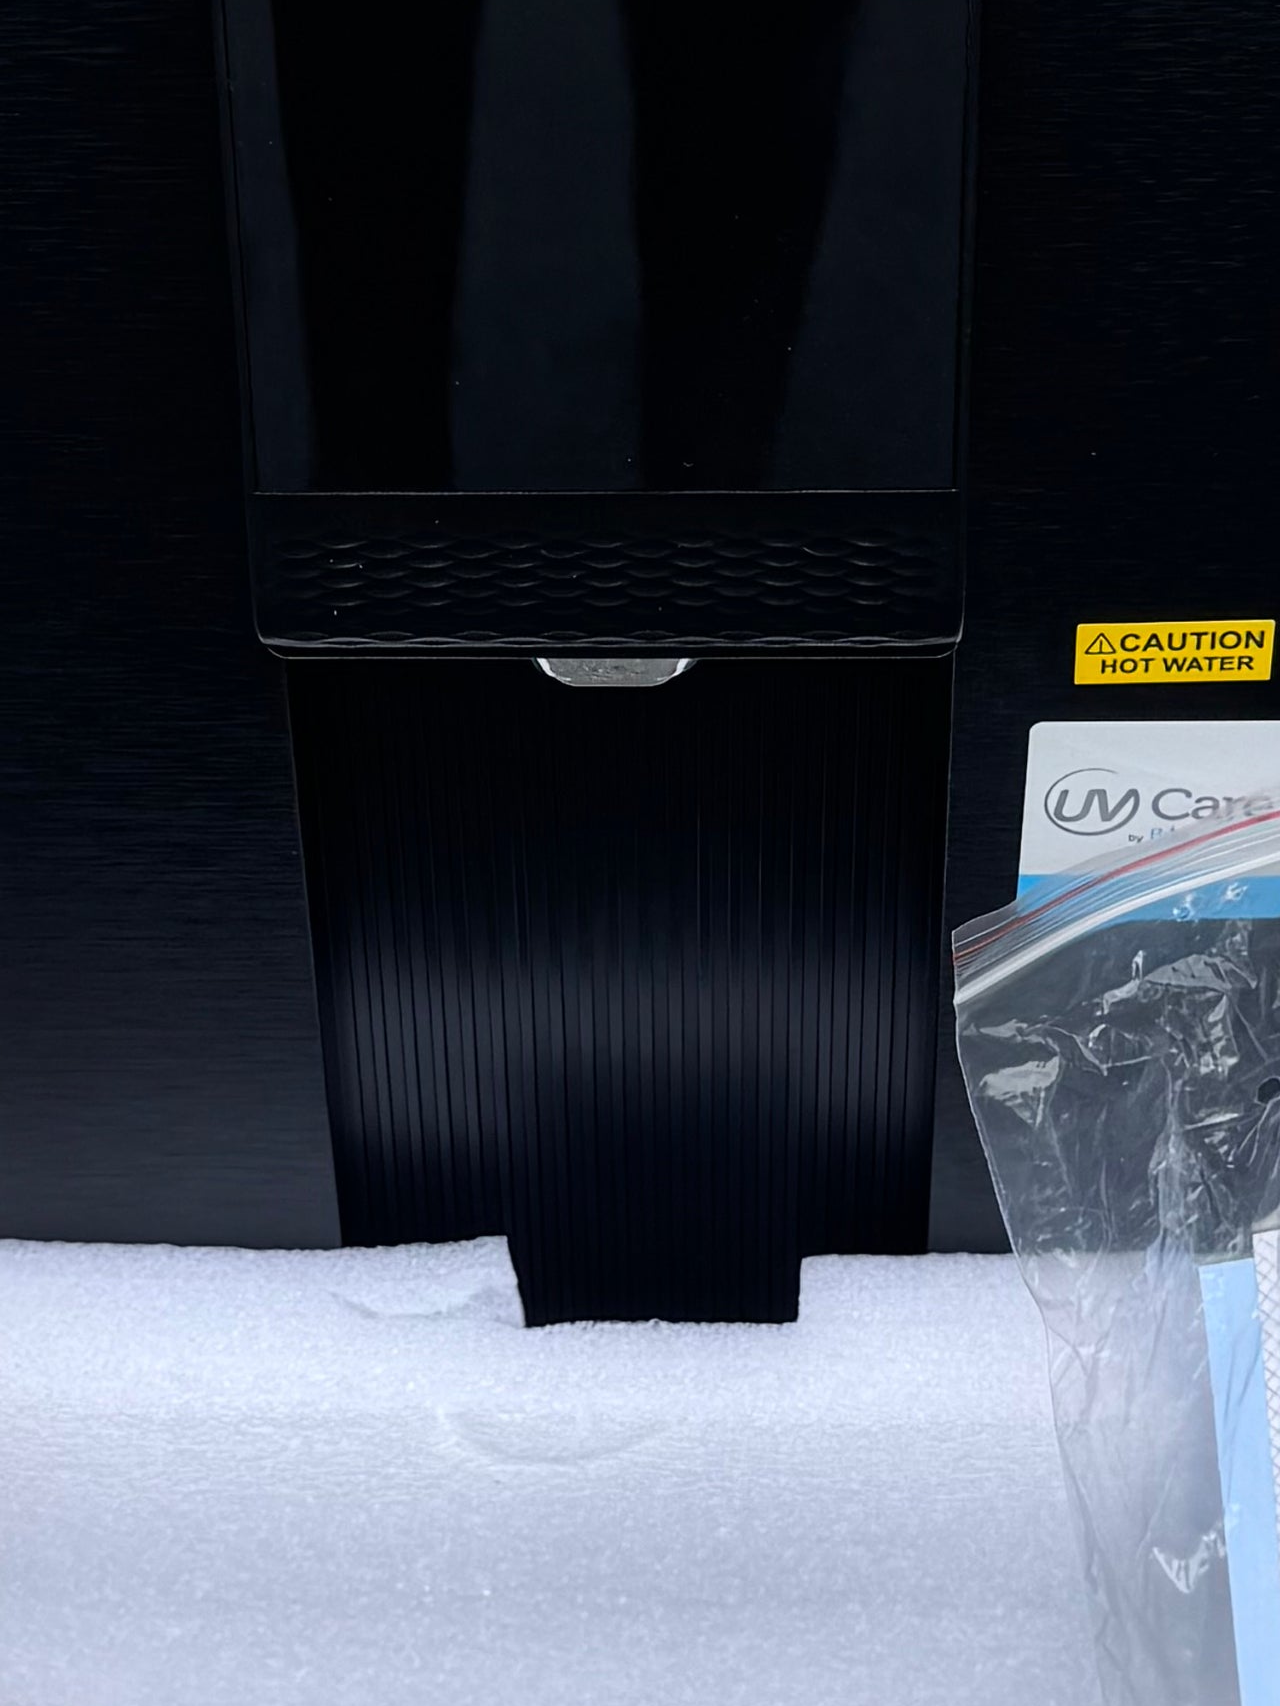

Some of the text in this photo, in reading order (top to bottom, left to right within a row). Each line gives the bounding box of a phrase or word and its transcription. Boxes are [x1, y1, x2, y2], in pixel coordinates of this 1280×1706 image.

[1119, 629, 1266, 653] CAUTION
[1099, 655, 1254, 674] HOT WATER
[1053, 788, 1141, 823] UV
[1127, 833, 1144, 843] by
